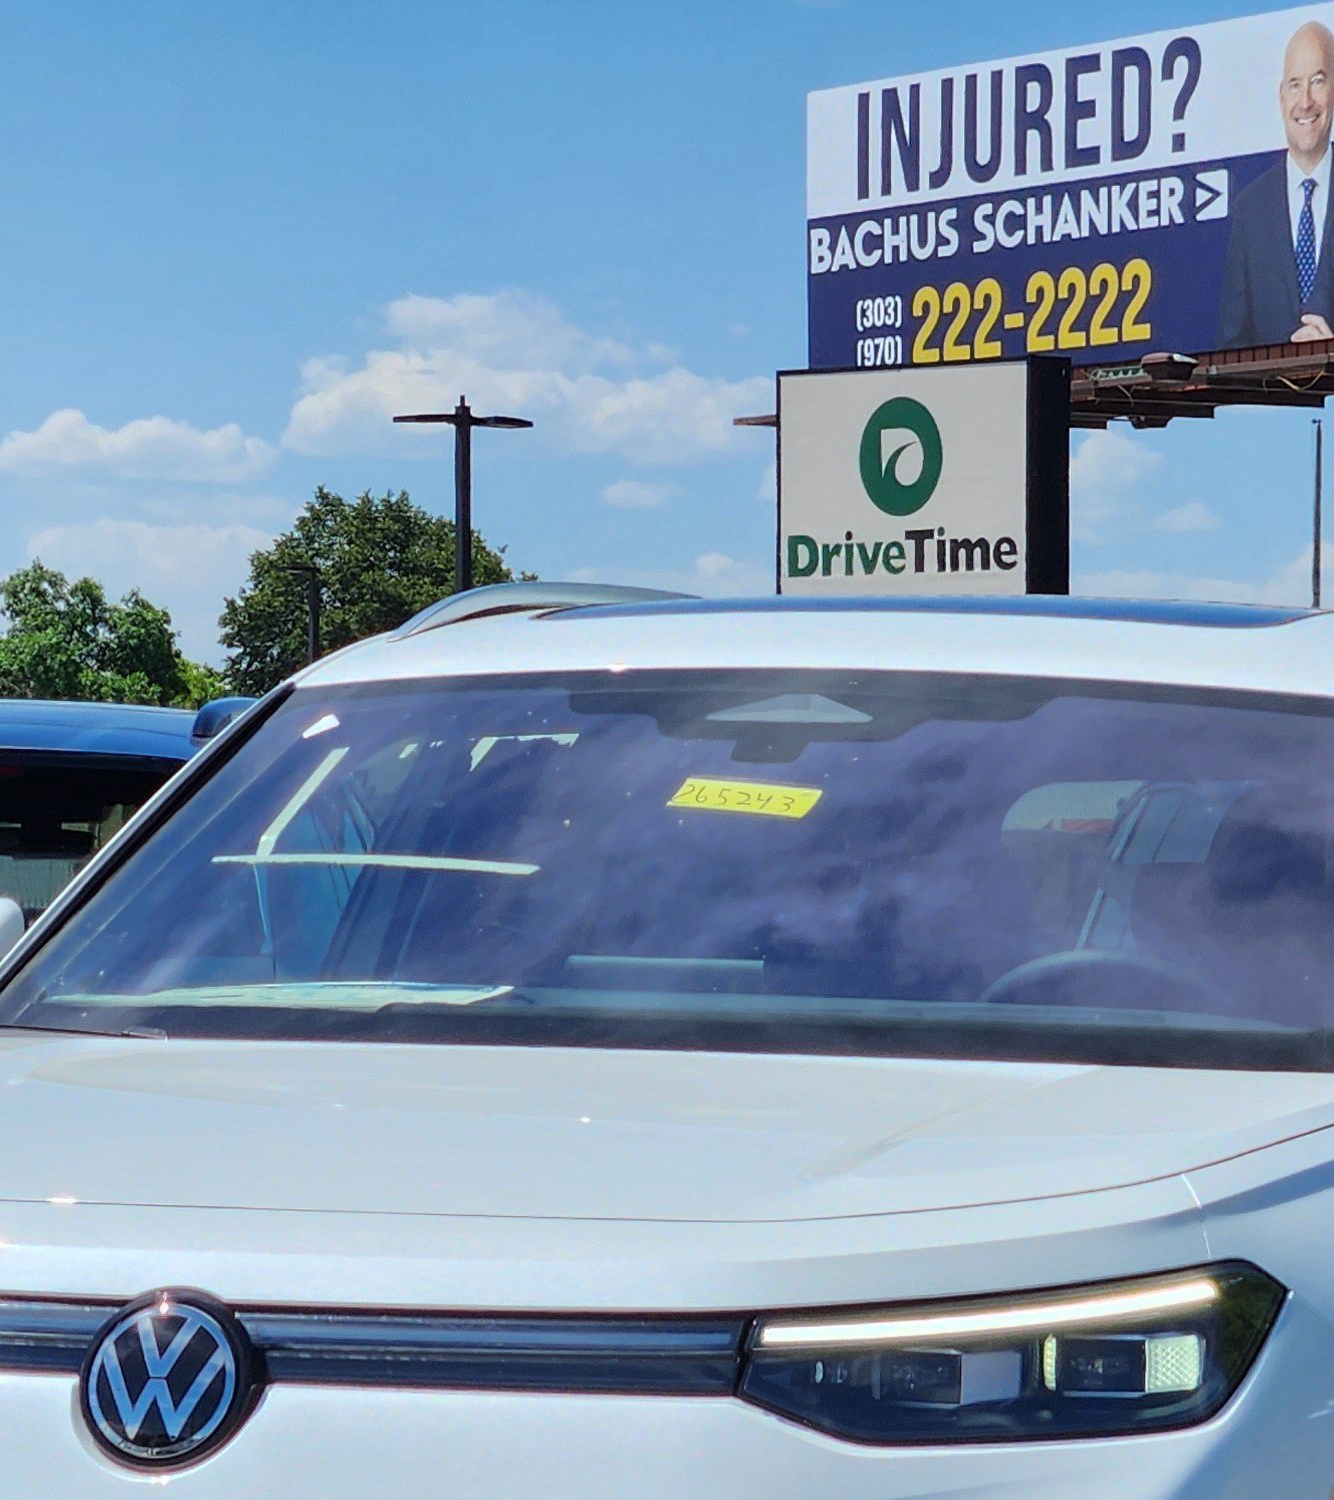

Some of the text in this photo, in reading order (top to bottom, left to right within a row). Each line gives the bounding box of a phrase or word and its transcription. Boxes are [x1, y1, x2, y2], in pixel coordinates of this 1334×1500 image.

[857, 36, 1203, 200] INJURED?
[810, 177, 1185, 274] BACHUS SCHANKER
[856, 258, 1152, 363] (303) 222-2222
[856, 336, 903, 367] (970)
[787, 526, 1018, 578] DriveTime
[674, 783, 796, 812] 265243
